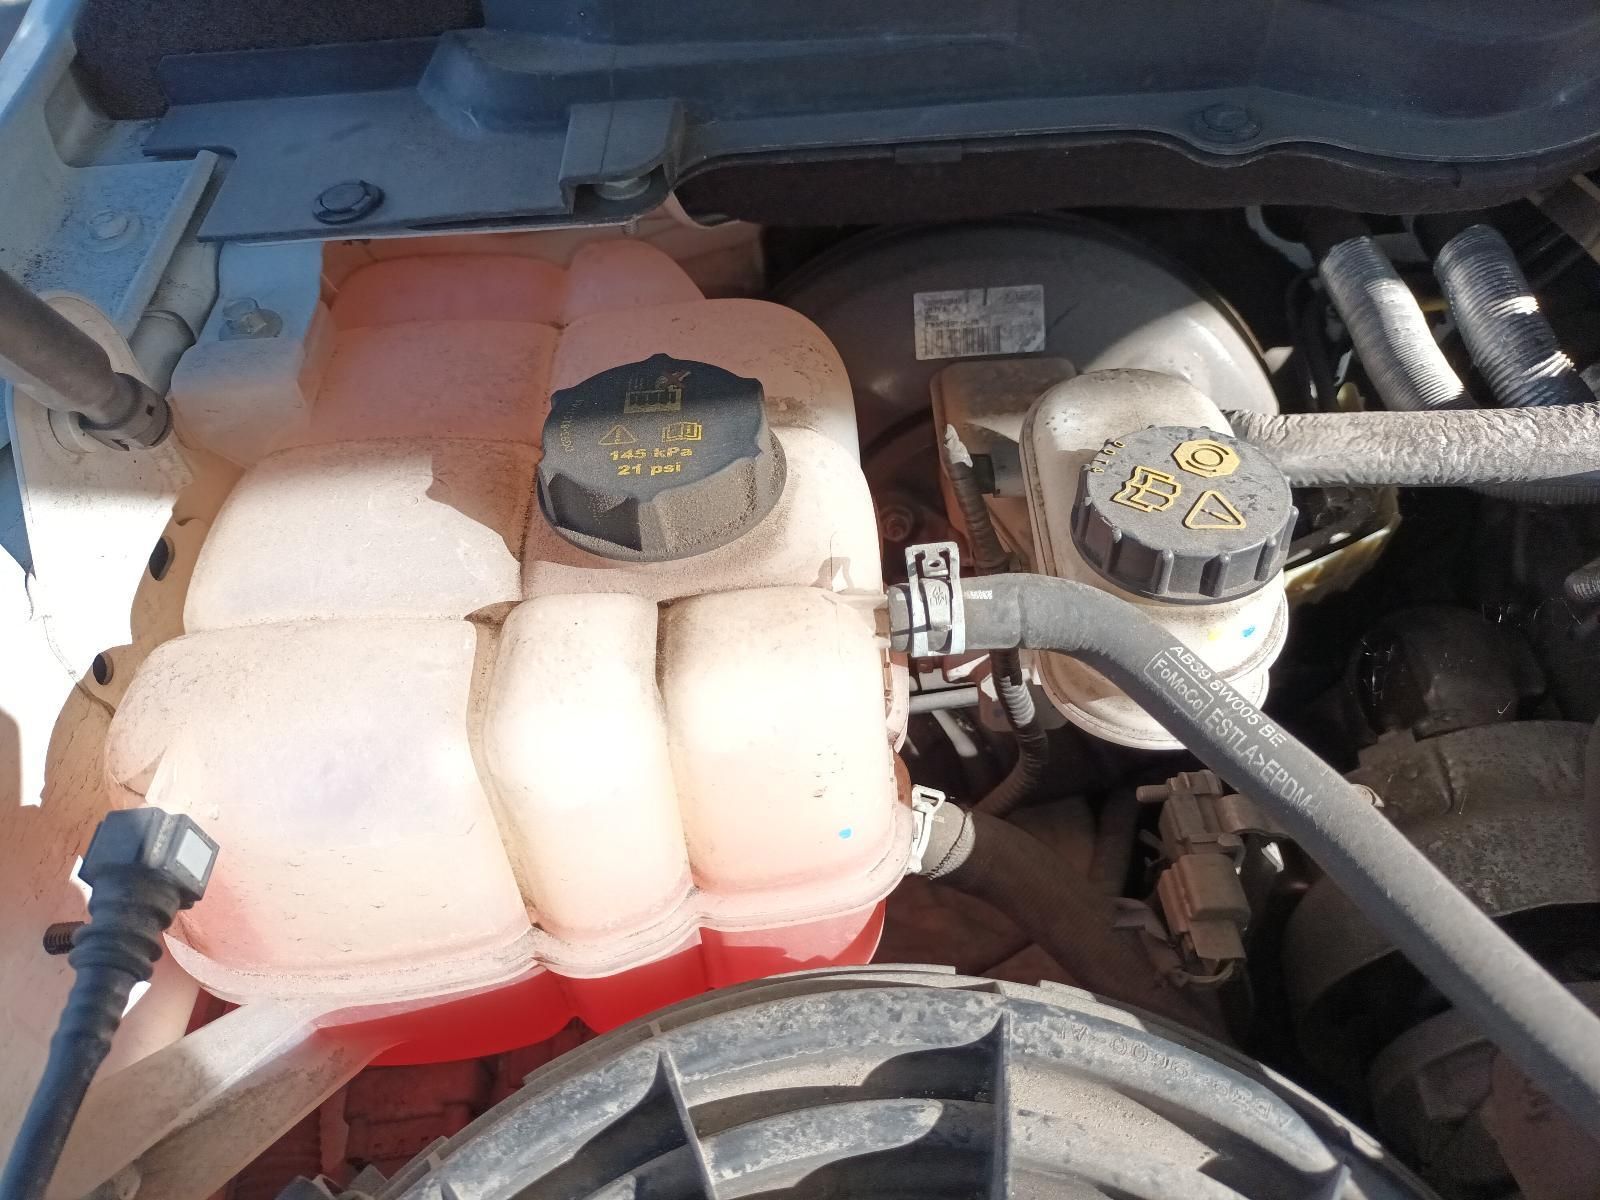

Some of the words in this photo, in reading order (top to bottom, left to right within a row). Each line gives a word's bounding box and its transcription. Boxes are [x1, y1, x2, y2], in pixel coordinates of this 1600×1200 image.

[609, 447, 647, 461] 145
[653, 446, 693, 459] kPa
[616, 463, 642, 476] 21
[650, 461, 682, 476] psi
[1152, 657, 1205, 711] FoMoCo
[1169, 645, 1212, 680] AB39
[1258, 723, 1288, 748] BE
